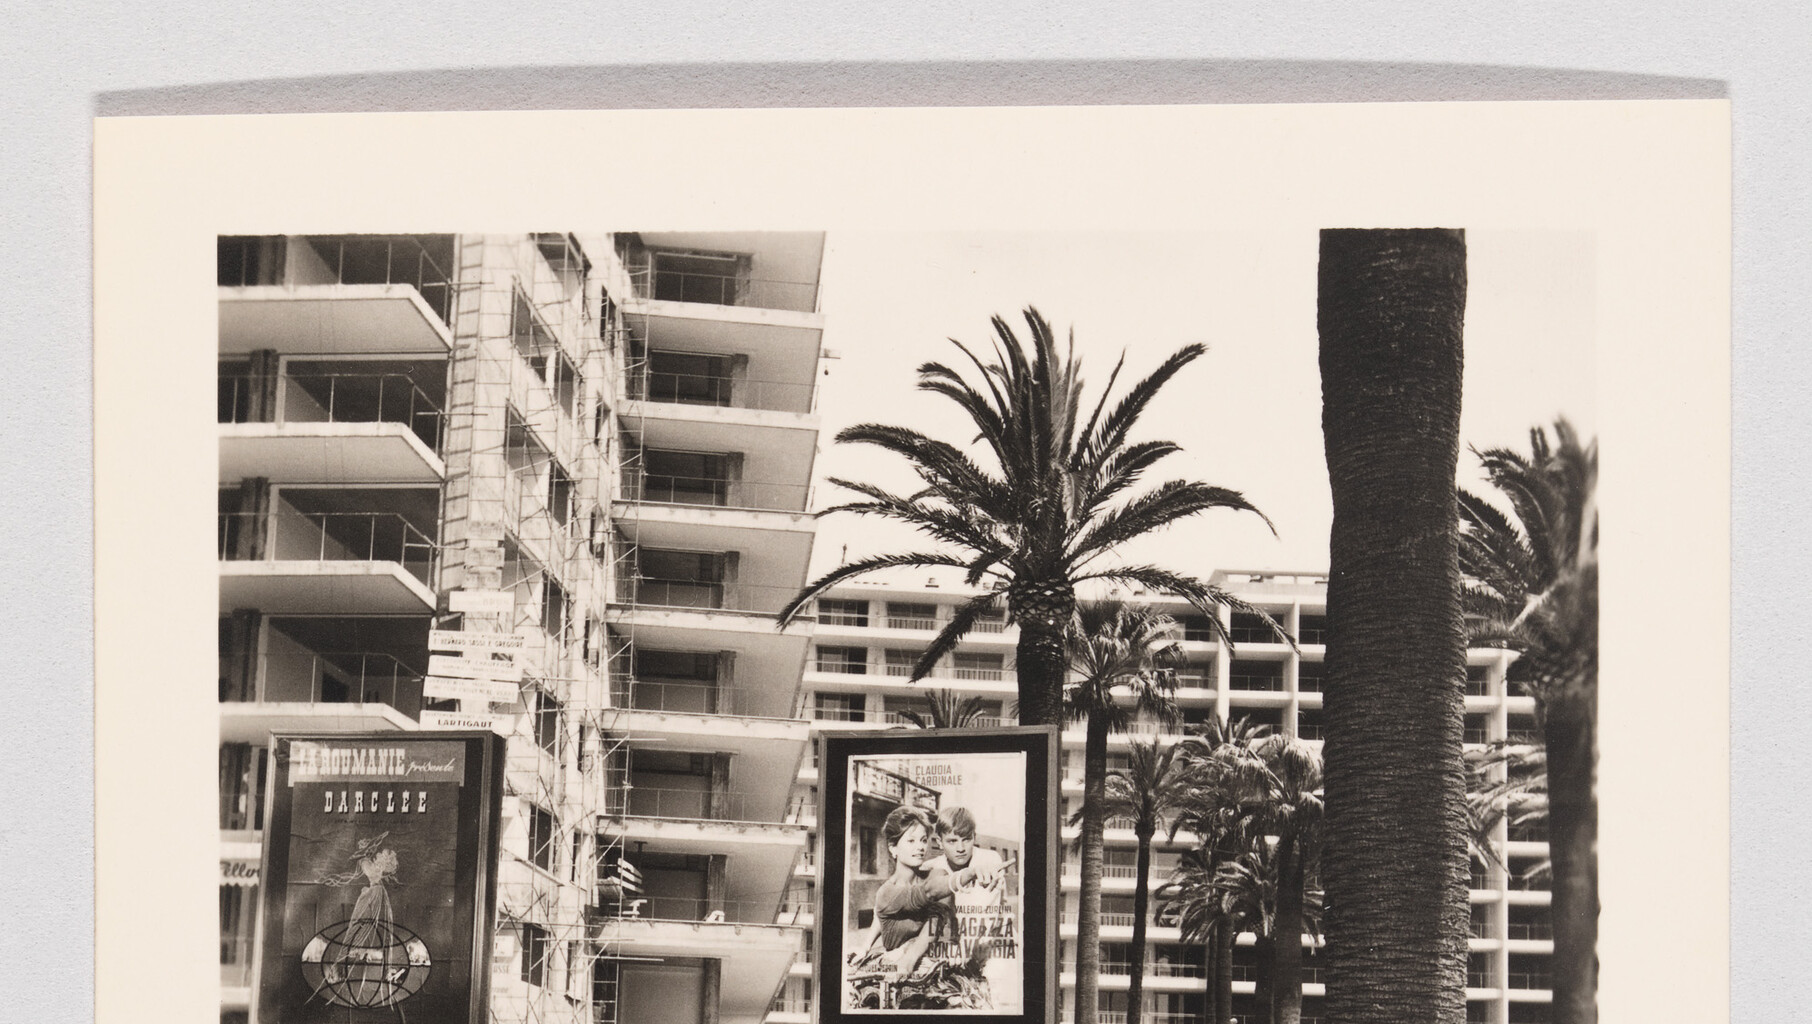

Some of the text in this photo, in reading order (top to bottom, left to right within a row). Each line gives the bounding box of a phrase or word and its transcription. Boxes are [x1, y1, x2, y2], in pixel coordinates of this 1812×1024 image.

[298, 748, 318, 775] LA
[320, 748, 406, 775] ROUMANIE
[915, 765, 952, 776] CLAUDIA
[915, 775, 963, 786] CARDINALE
